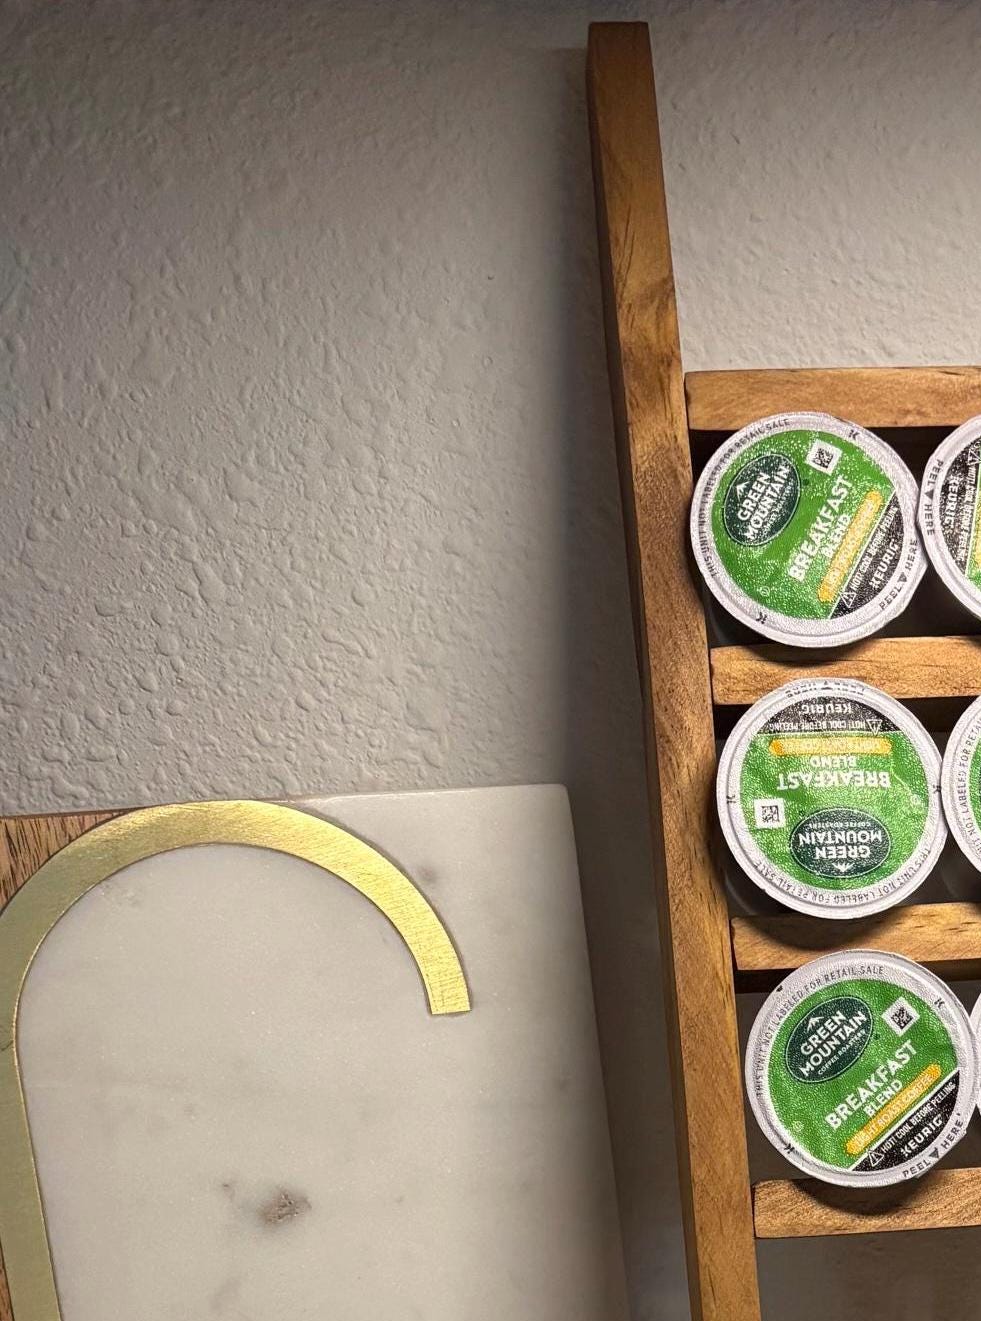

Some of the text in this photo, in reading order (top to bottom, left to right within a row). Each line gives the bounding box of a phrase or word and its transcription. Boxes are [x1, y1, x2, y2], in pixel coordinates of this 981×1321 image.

[735, 469, 773, 524] GREEN
[743, 461, 792, 542] MOUNTAIN
[925, 459, 943, 536] PEEL HERE
[944, 474, 957, 525] KEURIG
[788, 474, 851, 582] BREAKFAST
[820, 512, 850, 559] BLEND
[871, 540, 898, 587] KEURIG
[803, 702, 851, 712] KEURIG
[775, 770, 889, 790] BREAKFAST
[808, 756, 854, 769] BLEND
[797, 829, 881, 845] MOUNTAIN
[815, 844, 871, 858] GREEN
[798, 1010, 847, 1058] GREEN
[799, 1007, 868, 1077] MOUNTAIN
[816, 1026, 865, 1075] COFFEE ROASTERS
[825, 1035, 919, 1130] BREAKFAST
[864, 1074, 905, 1115] BLEND
[880, 1082, 955, 1153] HOT! COOL BEFORE PEELING
[901, 1116, 942, 1157] KEURIG
[903, 1118, 963, 1178] PEEL HERE
